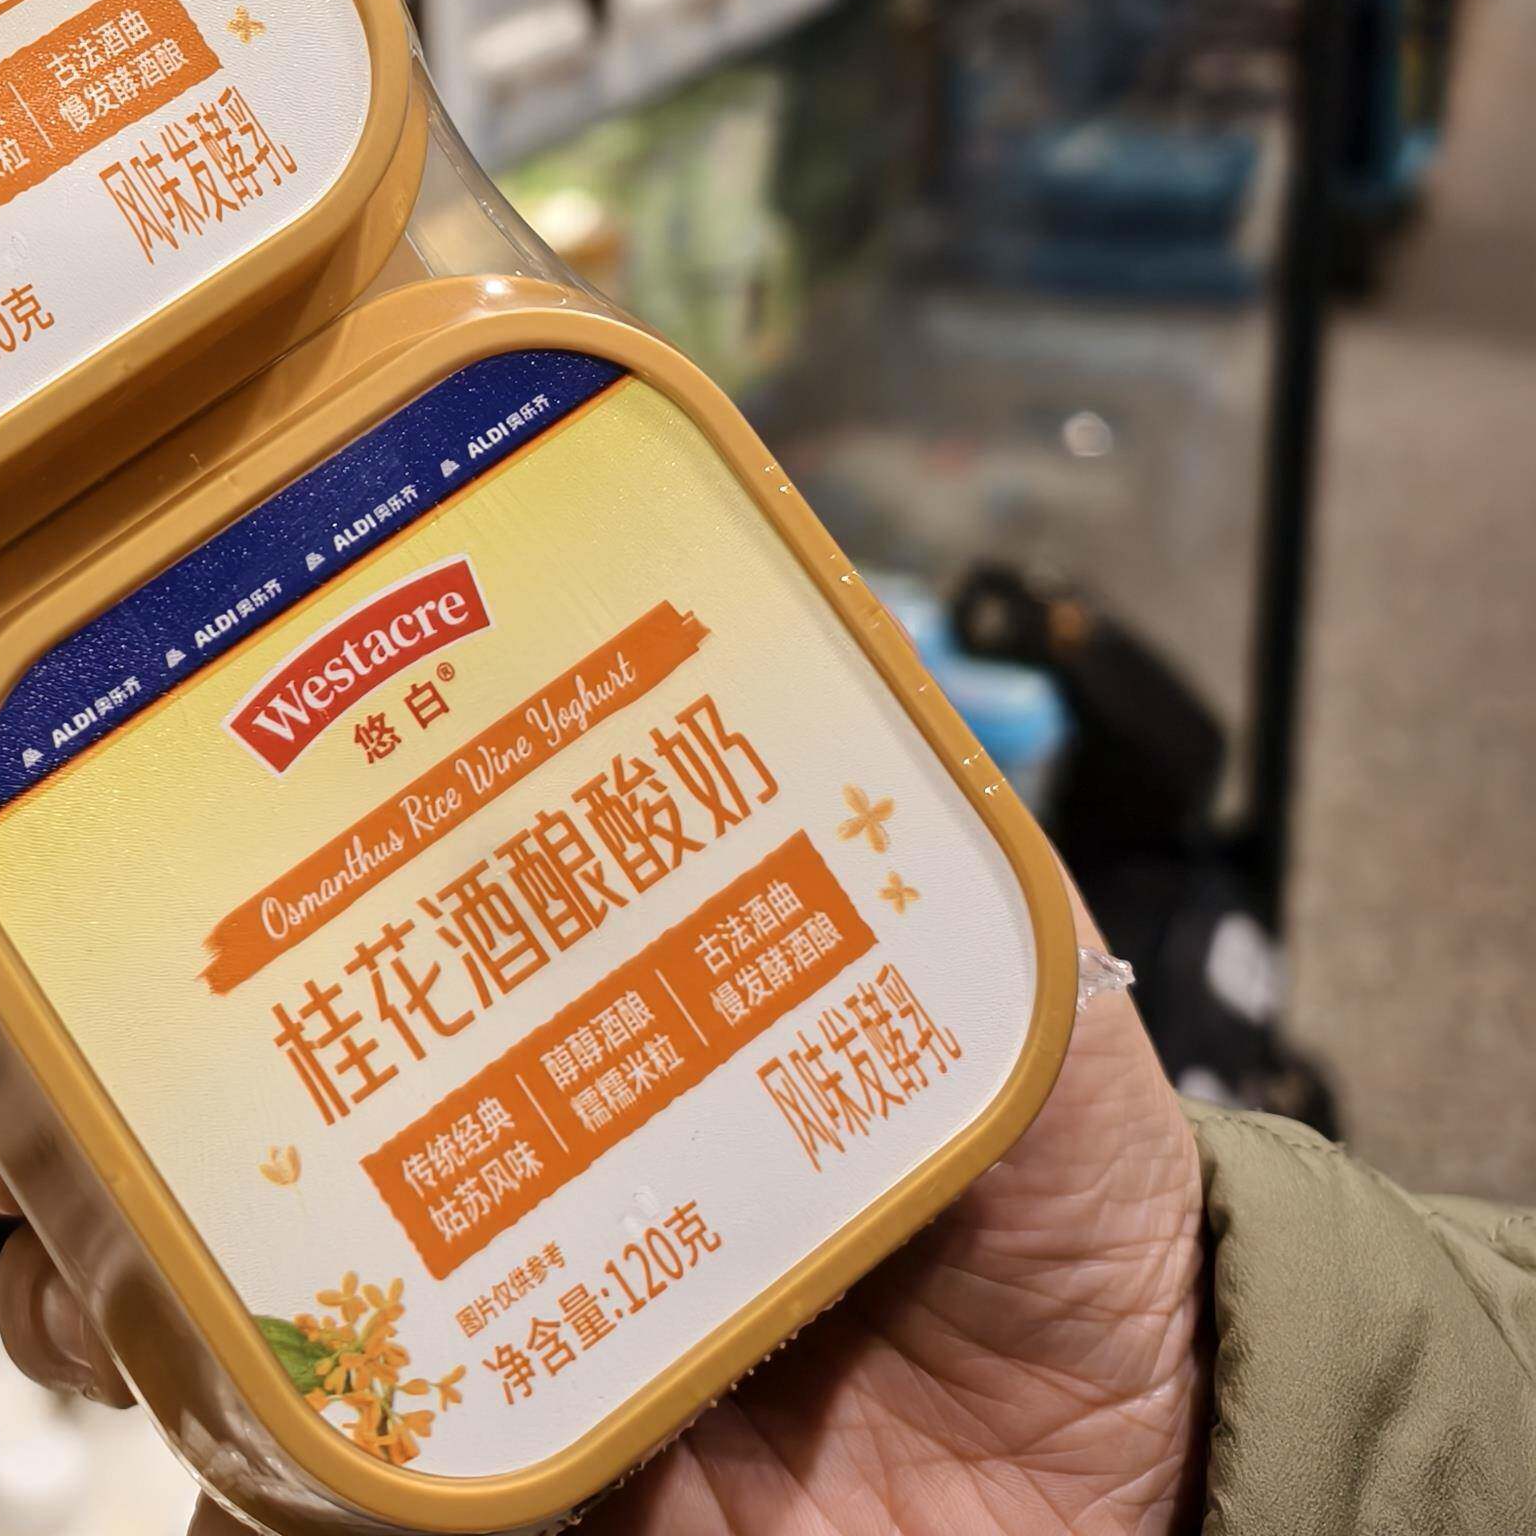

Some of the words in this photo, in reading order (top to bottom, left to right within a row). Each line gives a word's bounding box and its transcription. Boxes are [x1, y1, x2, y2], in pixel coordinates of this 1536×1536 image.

[46, 8, 152, 90] 古法酒曲
[58, 37, 189, 134] 慢发酵酒酿
[99, 86, 297, 265] 风味发酵乳
[252, 591, 470, 745] Westacre
[261, 837, 405, 940] Osmanthus
[398, 794, 462, 840] Rice
[457, 745, 532, 803] Wine
[526, 651, 635, 746] Yoghurt
[273, 693, 778, 1125] 桂花酒酿酸奶
[694, 879, 805, 975] 古法酒曲
[709, 911, 843, 1027] 慢发酵酒酿
[539, 991, 656, 1090] 醇醇酒酿
[571, 1033, 685, 1133] 糯糯米粒
[756, 963, 961, 1172] 风味发酵乳
[402, 1096, 516, 1197] 传统经典
[428, 1140, 544, 1244] 姑苏风味
[455, 1240, 565, 1338] 图片仅供参考
